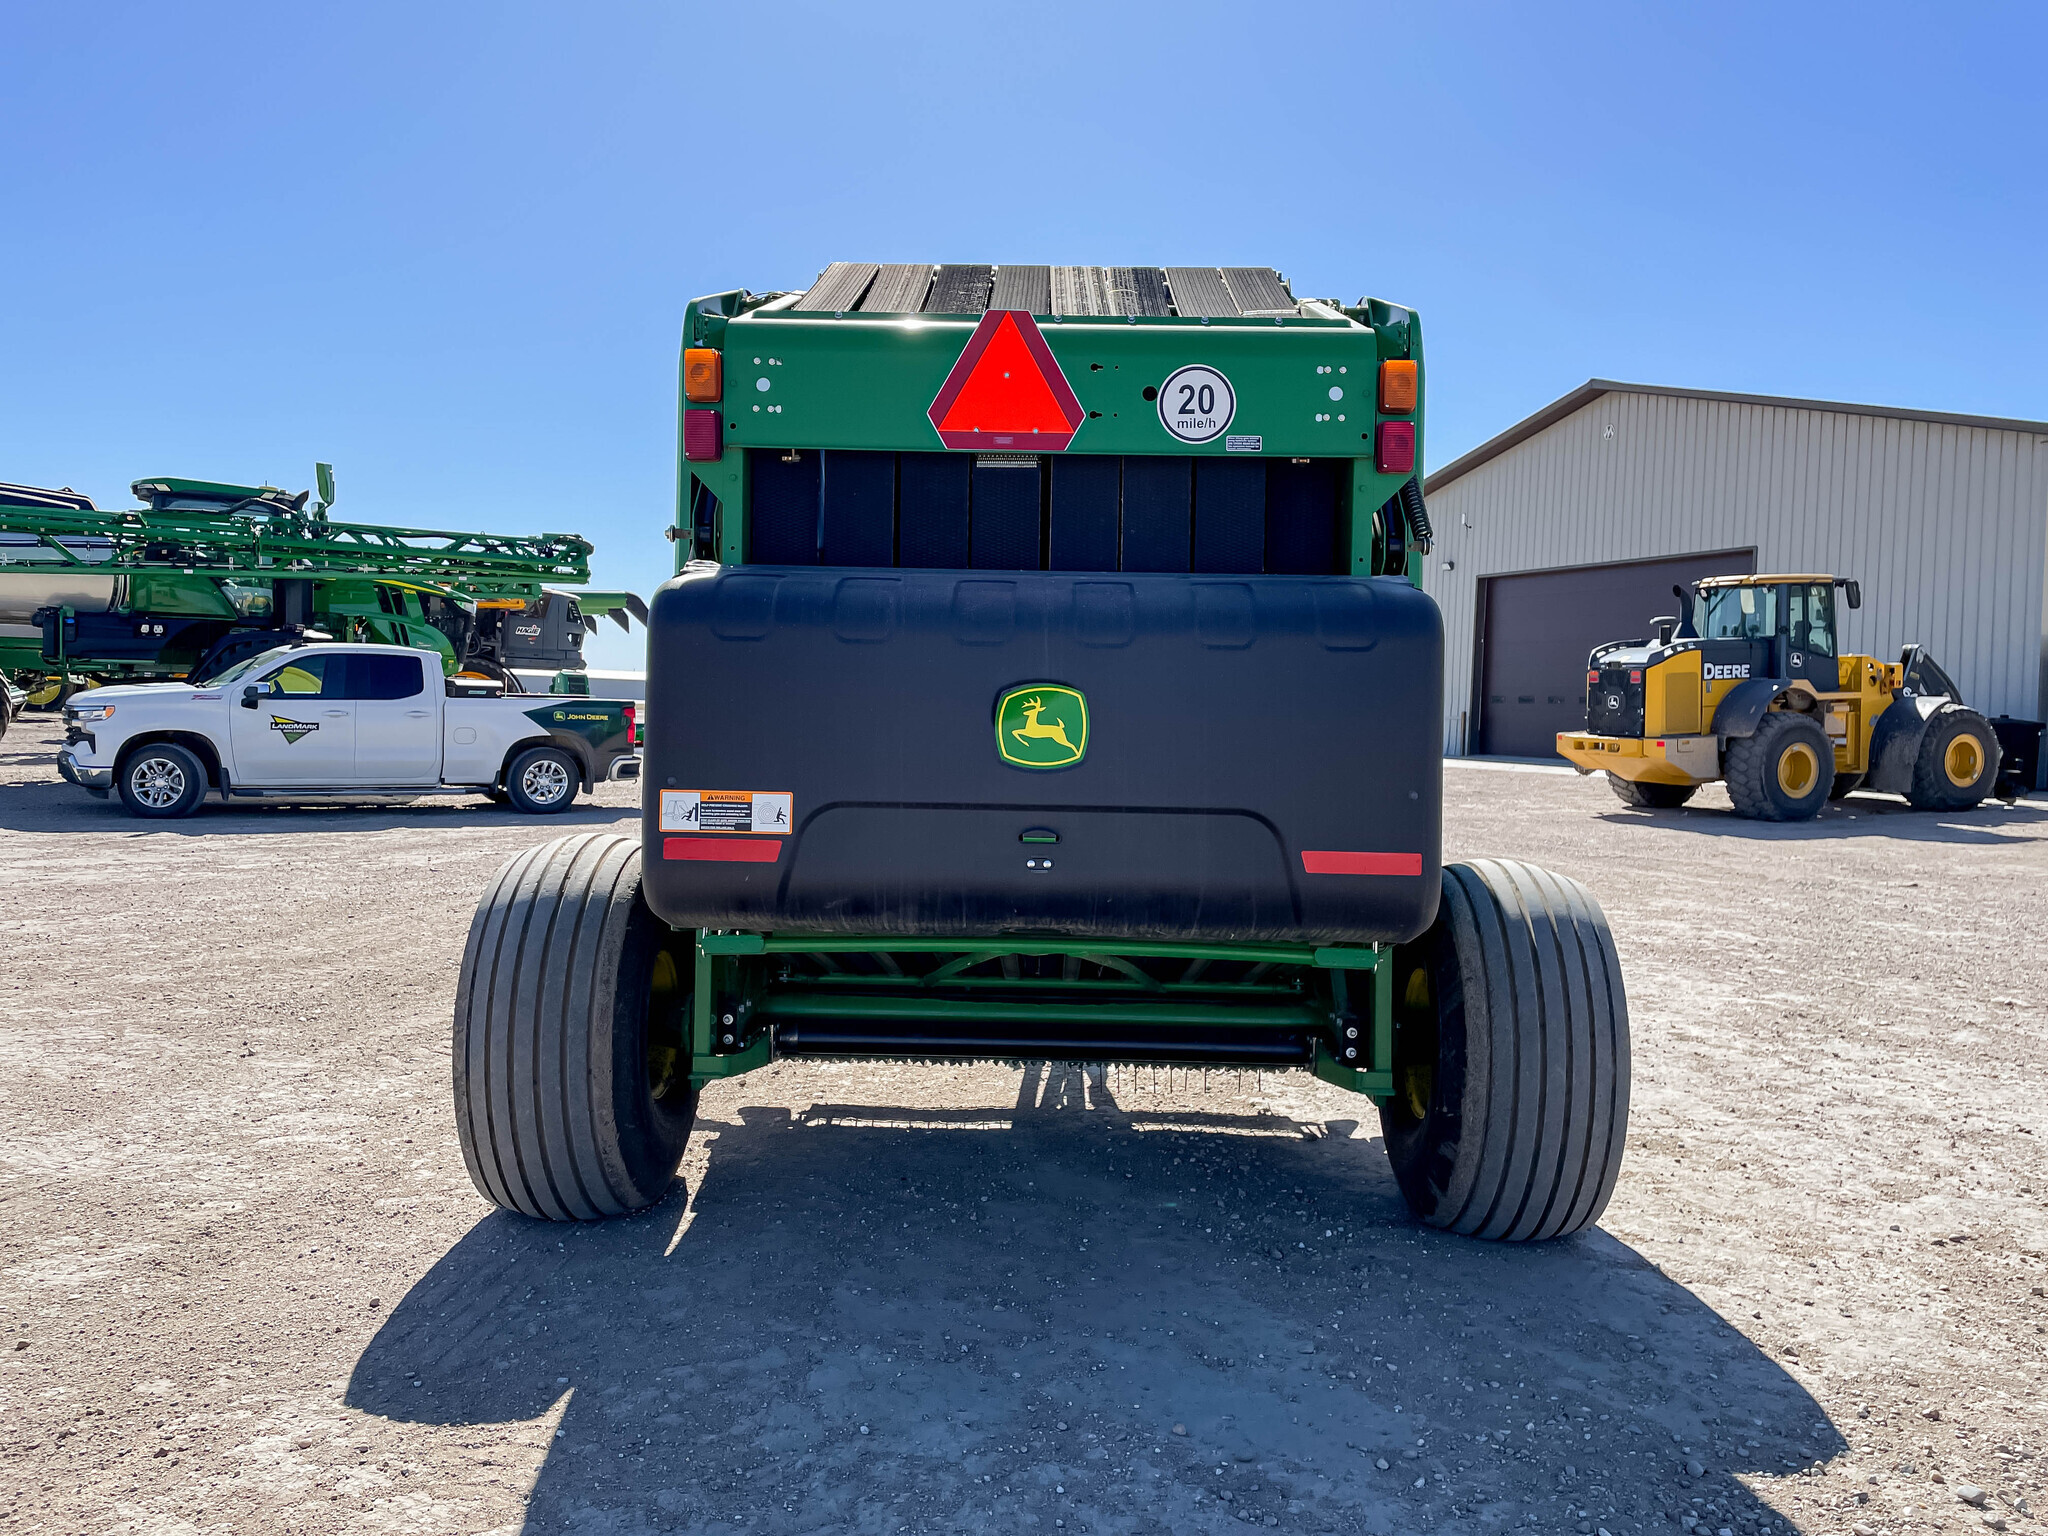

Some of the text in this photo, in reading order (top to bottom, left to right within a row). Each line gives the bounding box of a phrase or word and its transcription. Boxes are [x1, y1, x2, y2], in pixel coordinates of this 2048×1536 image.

[1178, 384, 1215, 415] 20
[1177, 417, 1216, 429] mile/h
[1703, 662, 1750, 680] DEERE
